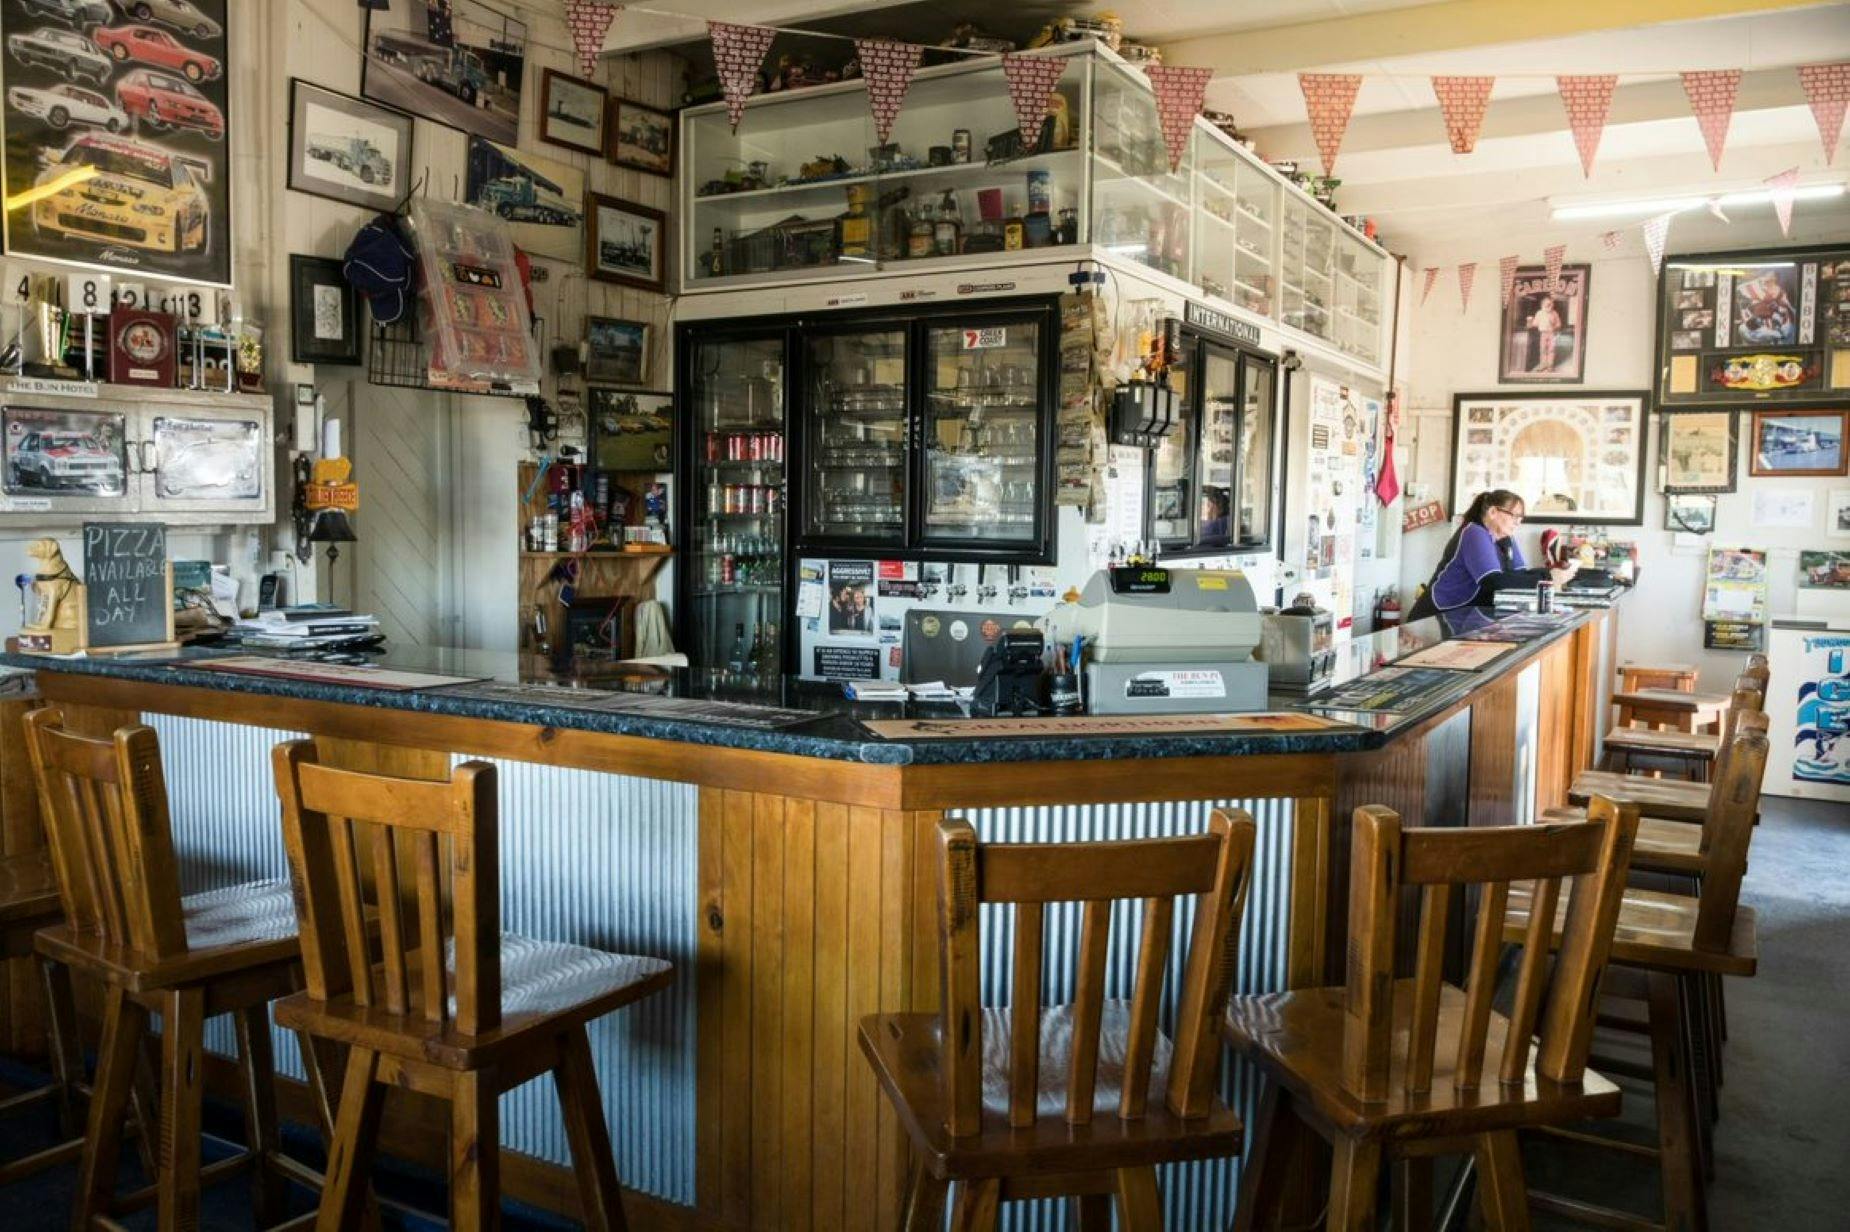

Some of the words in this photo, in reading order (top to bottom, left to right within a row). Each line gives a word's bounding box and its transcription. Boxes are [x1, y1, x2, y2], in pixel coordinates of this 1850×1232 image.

[17, 275, 29, 301] 4
[83, 281, 97, 307] 8
[1189, 302, 1260, 345] INTERNATIONAL
[60, 383, 96, 394] HOTEL
[86, 526, 166, 557] PIZZA
[107, 583, 145, 606] ALL
[95, 606, 136, 626] DAY
